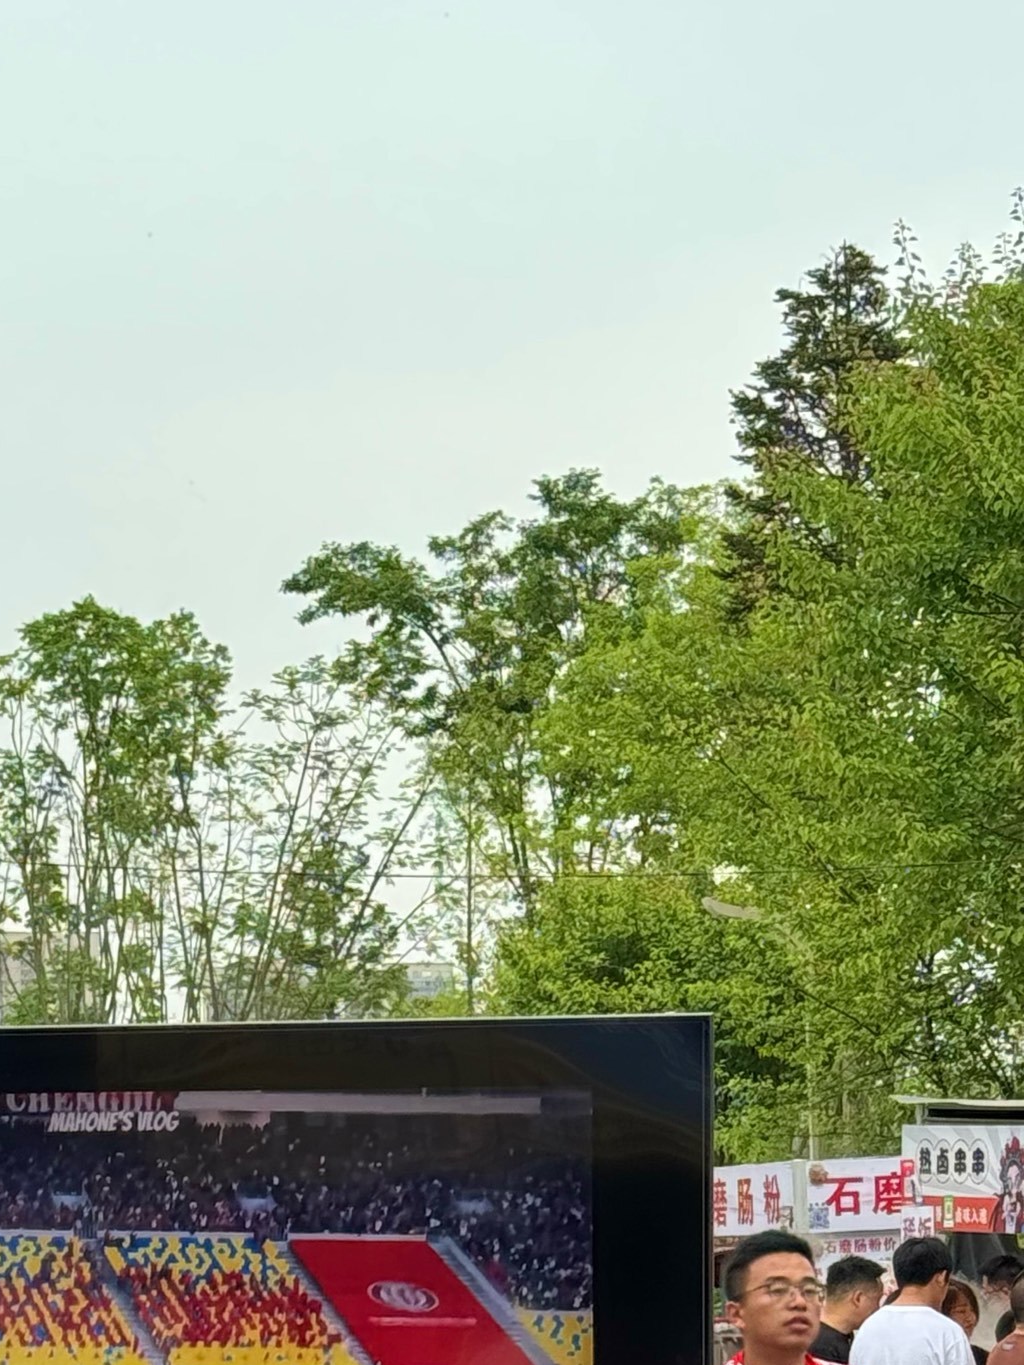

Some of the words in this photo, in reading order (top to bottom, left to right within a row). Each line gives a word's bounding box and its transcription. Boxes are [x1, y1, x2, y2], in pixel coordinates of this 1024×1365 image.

[48, 1111, 133, 1133] MAHONE'S
[136, 1110, 180, 1132] VLOG
[919, 1146, 985, 1176] 热卤串串
